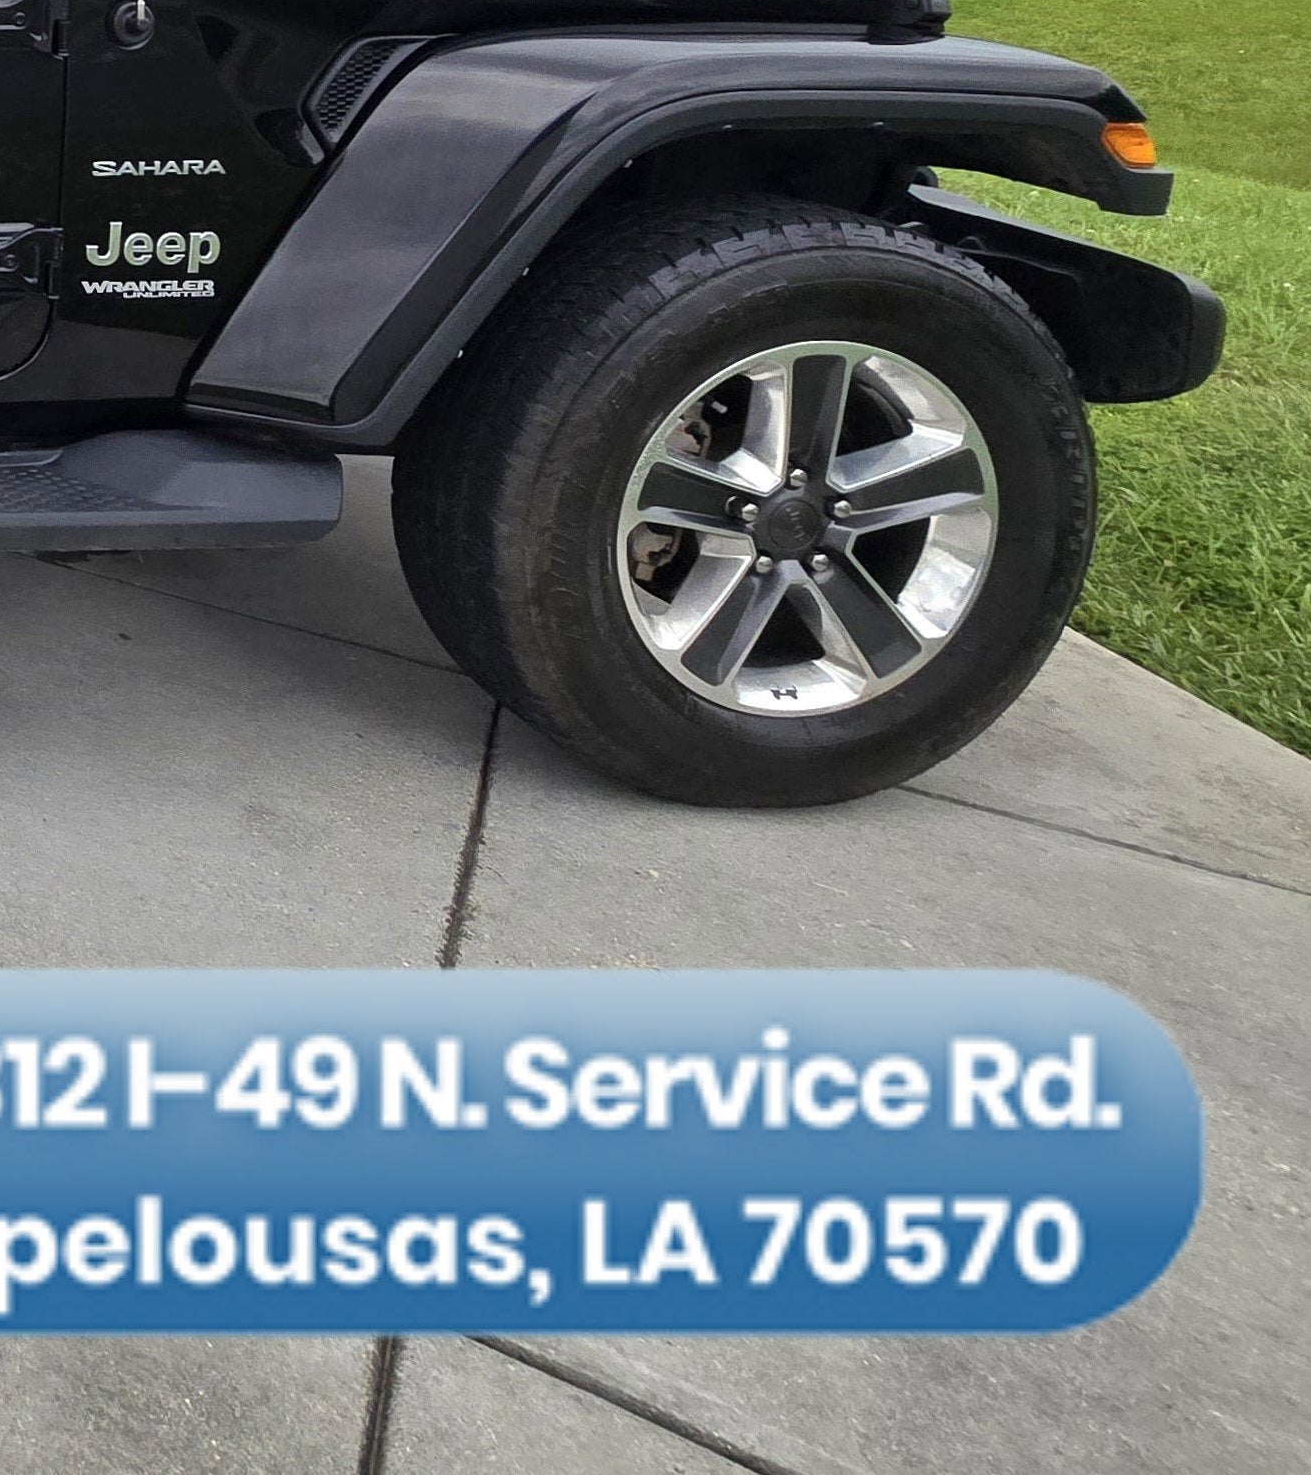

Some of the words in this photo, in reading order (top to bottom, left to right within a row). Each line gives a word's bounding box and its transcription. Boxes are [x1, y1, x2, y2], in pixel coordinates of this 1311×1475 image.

[91, 159, 226, 177] SAHARA
[85, 221, 221, 274] Jeep
[80, 279, 215, 294] WRANGLER
[122, 291, 215, 299] UNLIMITED
